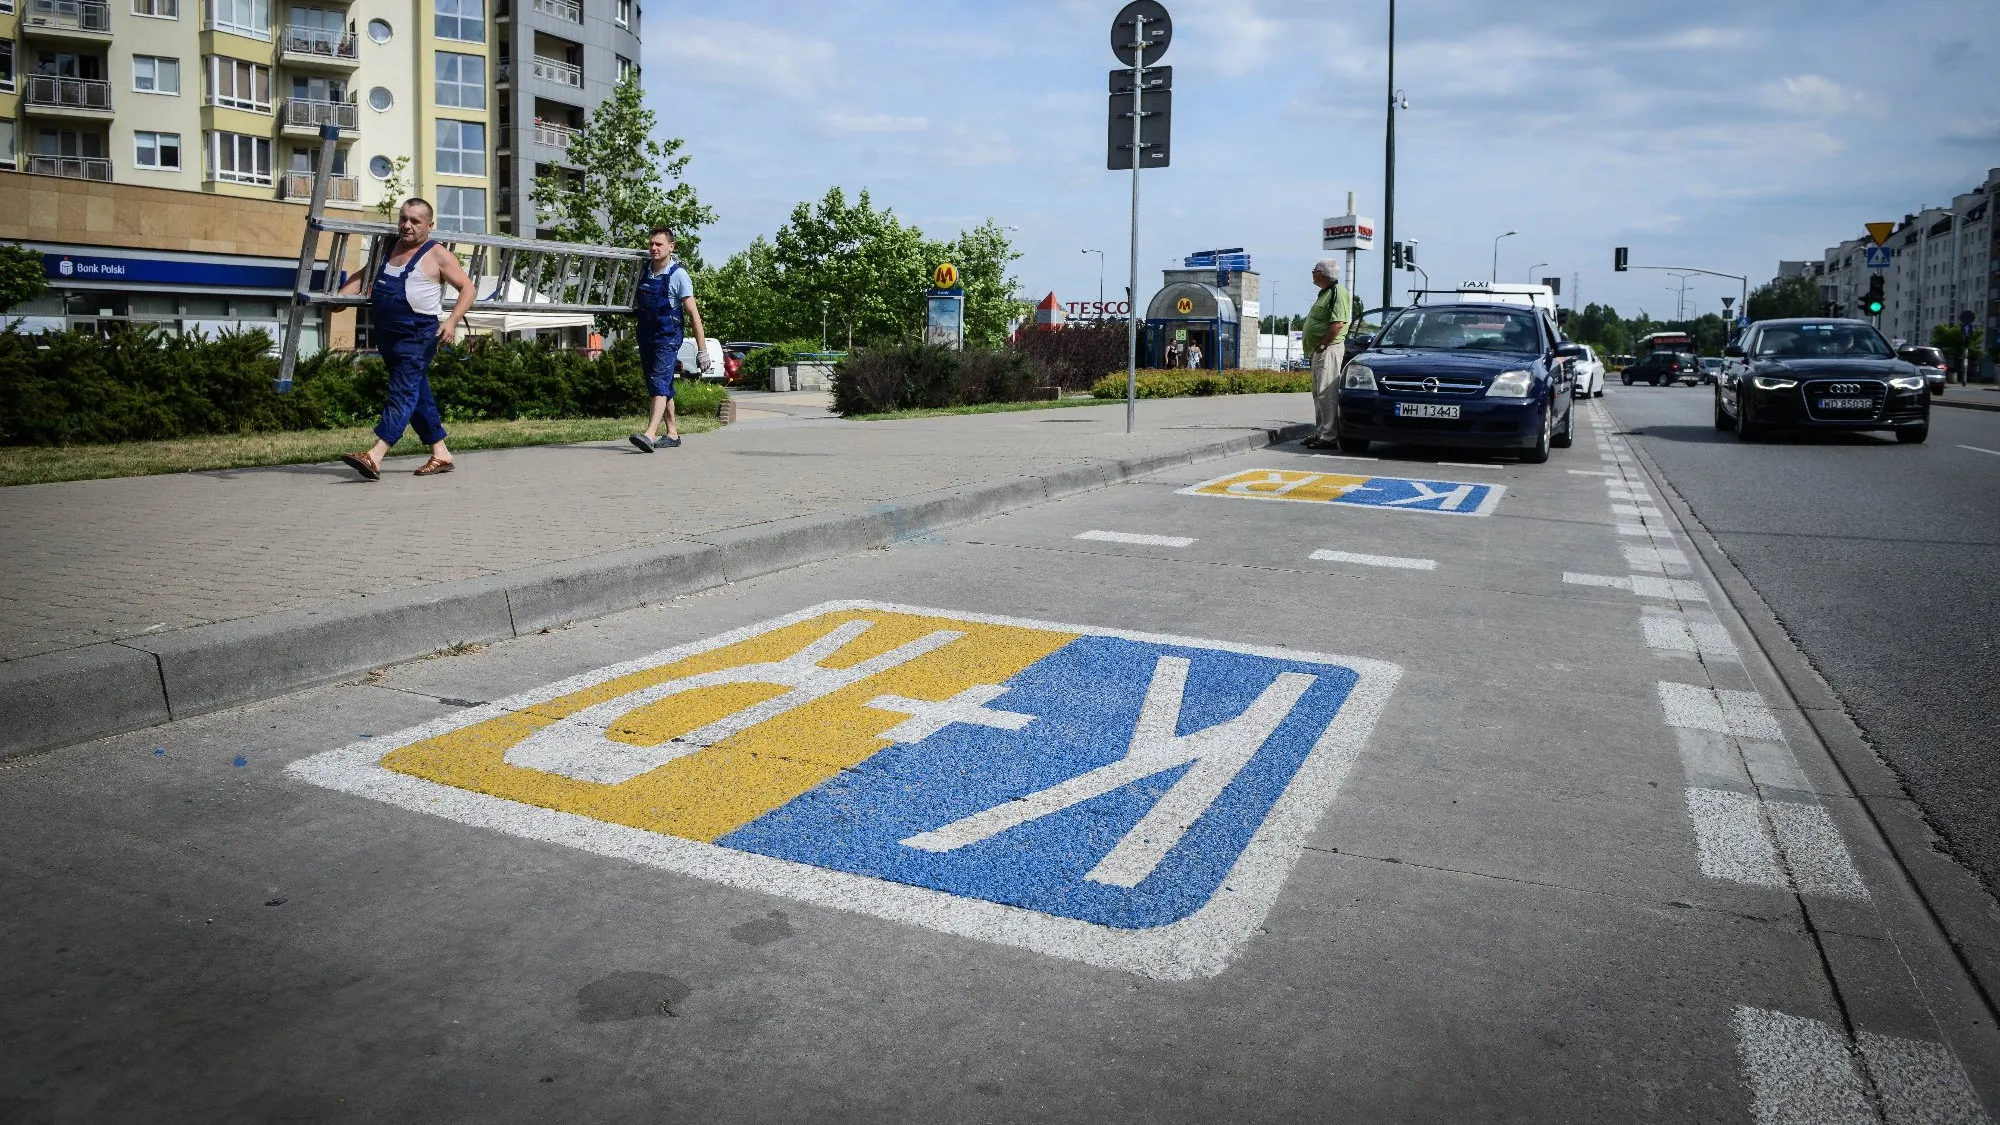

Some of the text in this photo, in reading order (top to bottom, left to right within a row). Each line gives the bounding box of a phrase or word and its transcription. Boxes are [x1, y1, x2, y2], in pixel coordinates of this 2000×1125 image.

[1324, 224, 1355, 236] TESCO
[77, 263, 125, 275] Bank Polski
[936, 266, 954, 284] M
[1066, 301, 1131, 315] TESCO
[1402, 404, 1458, 418] WH 13443
